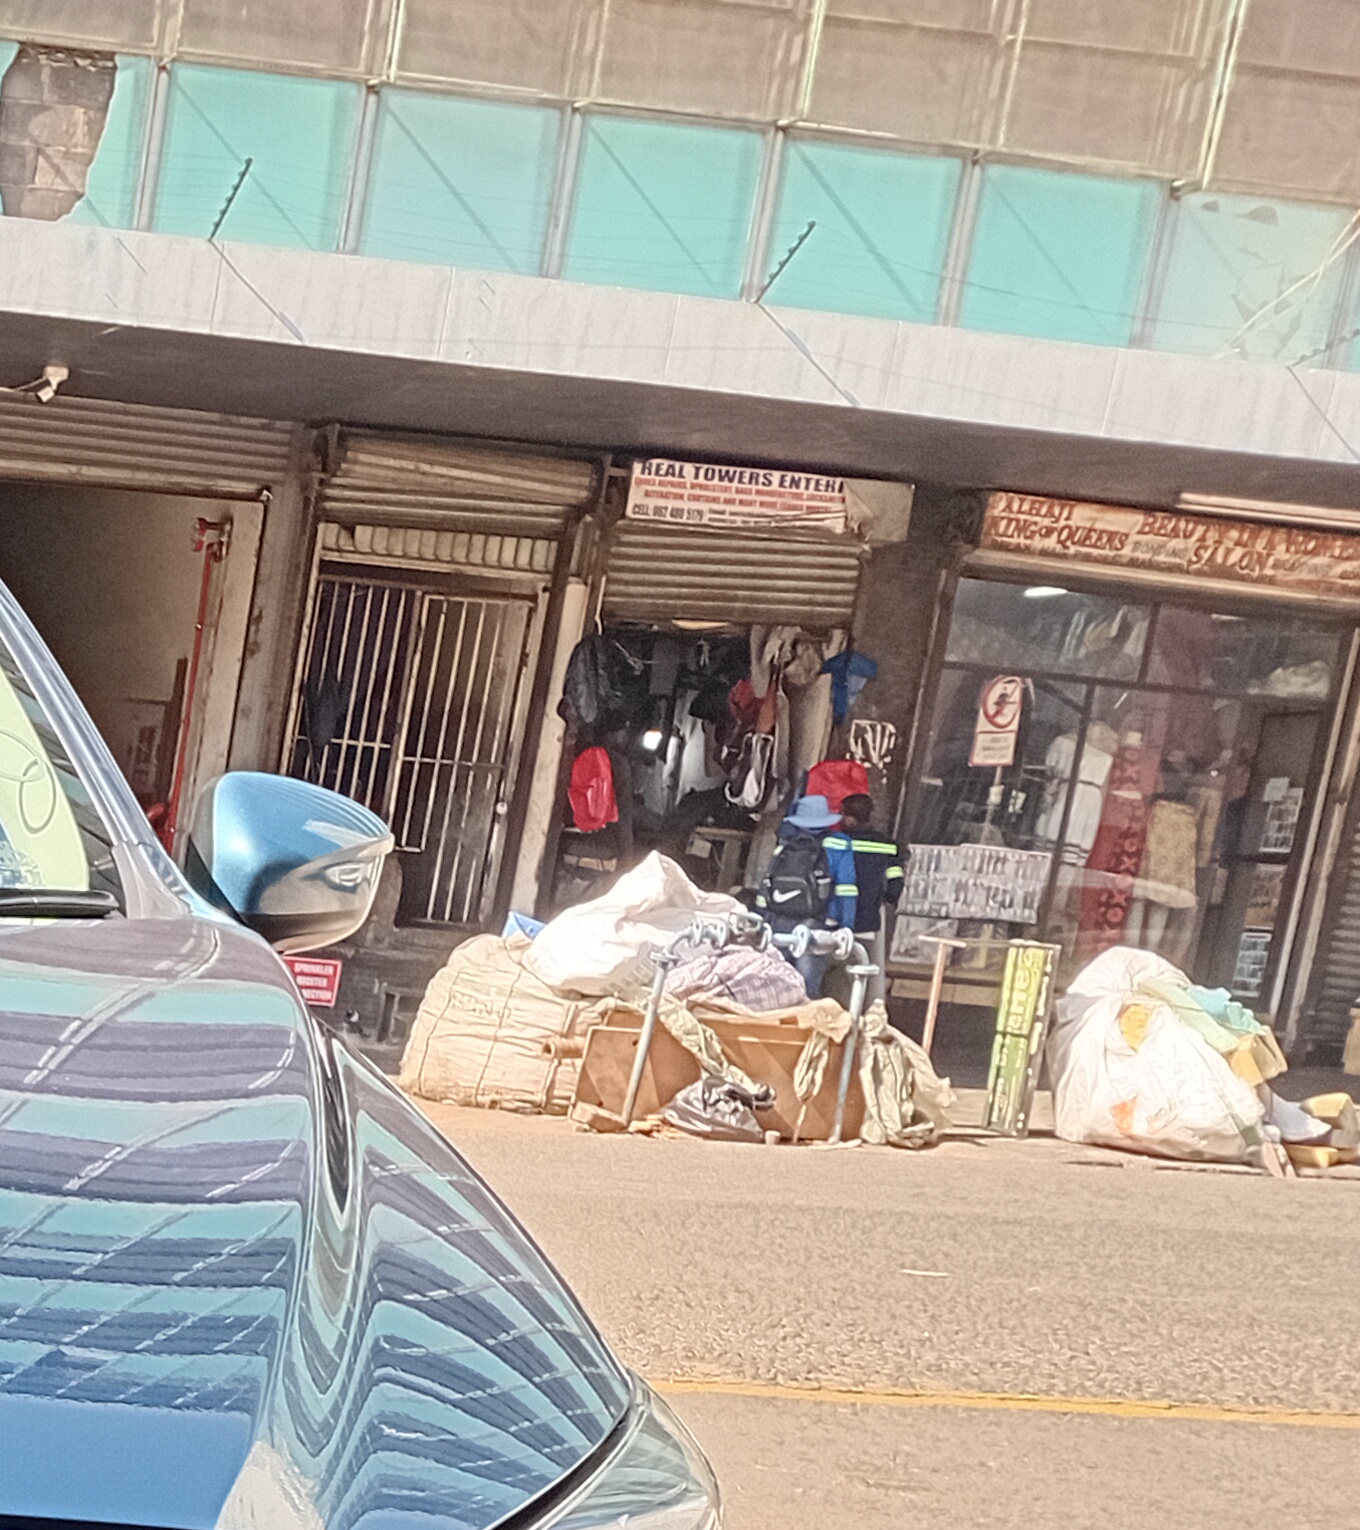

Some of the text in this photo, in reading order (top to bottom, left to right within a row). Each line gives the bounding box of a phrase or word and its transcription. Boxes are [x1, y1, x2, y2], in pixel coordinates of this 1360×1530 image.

[693, 465, 773, 487] TOWERS
[990, 514, 1038, 540] KING
[1057, 524, 1130, 551] QUEENS
[1190, 541, 1277, 574] SALON
